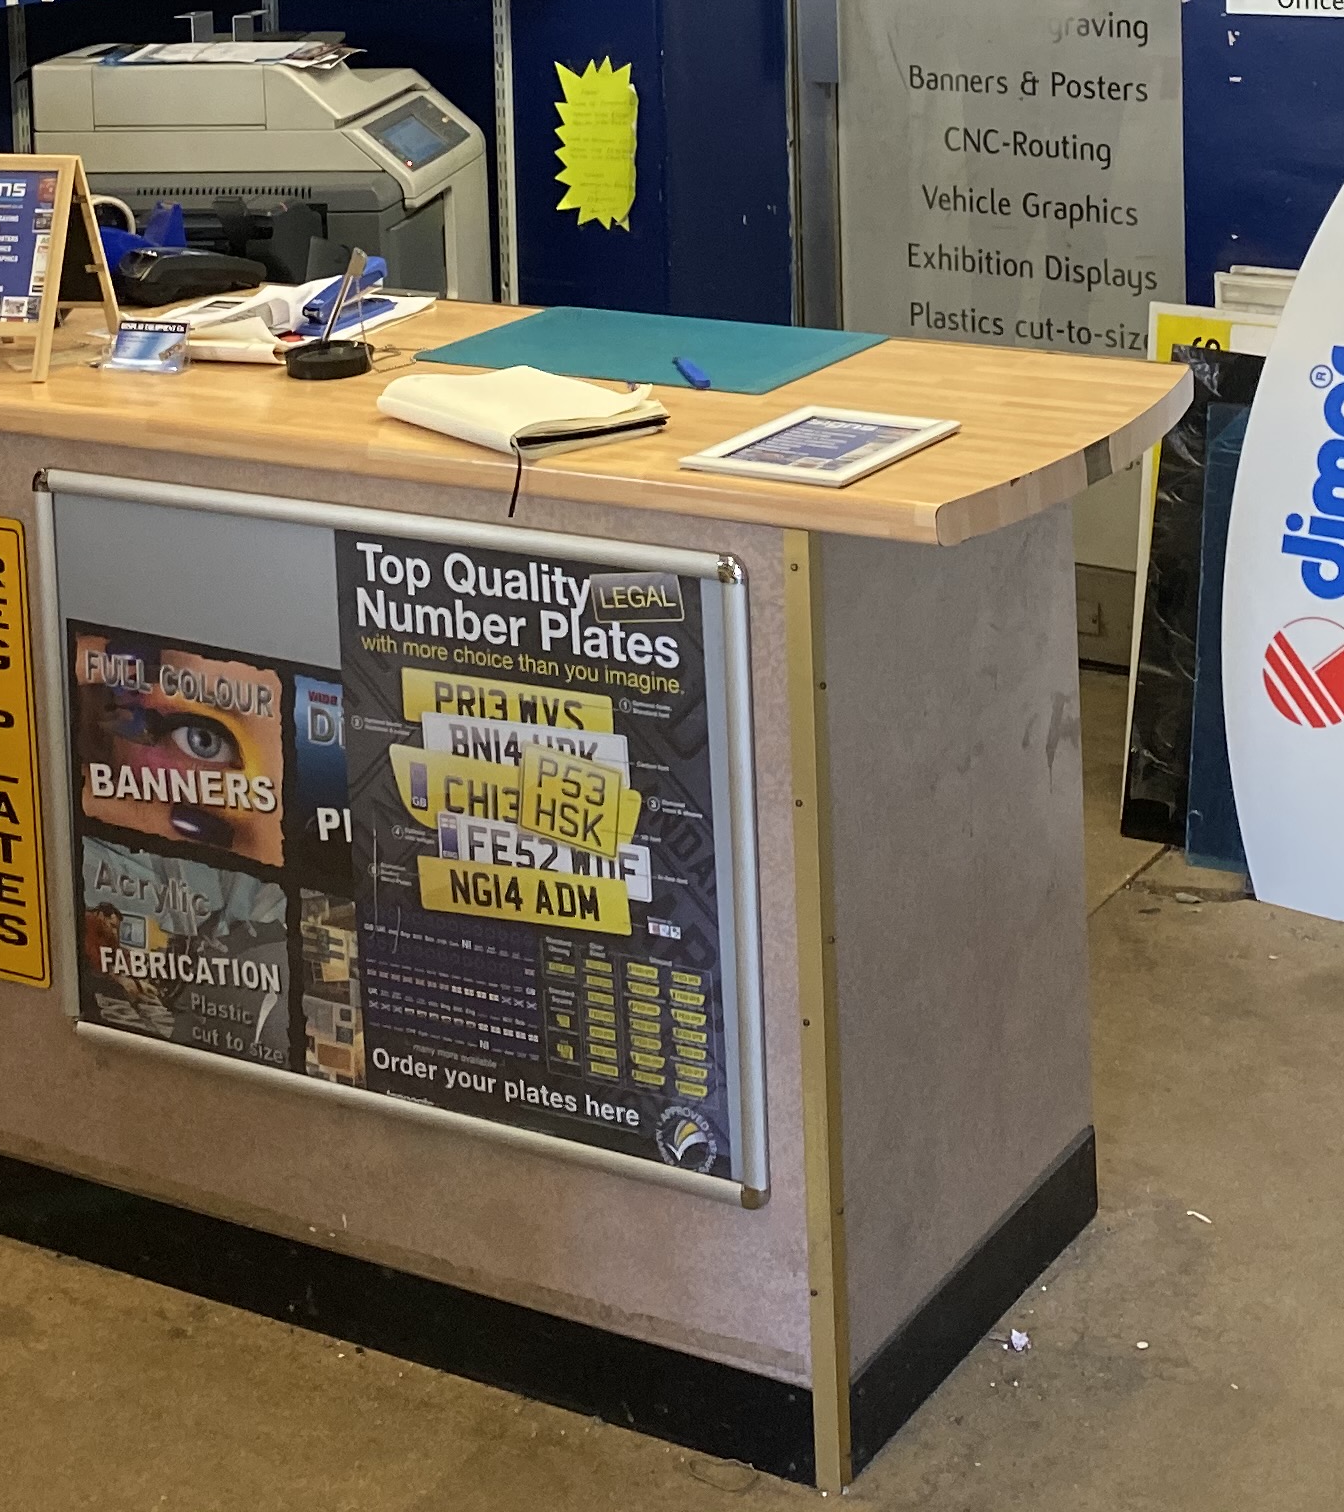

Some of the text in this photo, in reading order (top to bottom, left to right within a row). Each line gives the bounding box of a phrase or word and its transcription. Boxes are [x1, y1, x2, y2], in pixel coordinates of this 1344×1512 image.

[908, 64, 1149, 102] Banners & Posters
[944, 126, 1112, 170] CNC-Routing
[922, 184, 1139, 229] Vehicle Graphics
[907, 242, 1158, 297] Exhibition Displays
[910, 302, 1005, 337] Plastics
[356, 541, 592, 616] Top Quality
[599, 584, 678, 610] LEGAL
[356, 586, 681, 670] Number Plates
[85, 649, 275, 719] FULL COLOUR
[361, 634, 398, 656] with
[402, 643, 449, 663] more
[453, 645, 514, 672] choice
[518, 653, 560, 677] than
[564, 662, 599, 686] you
[518, 692, 586, 732] WVS
[89, 761, 278, 813] BANNERS
[411, 795, 427, 809] GB
[538, 756, 606, 807] P53
[535, 794, 604, 848] HSK
[467, 825, 559, 873] FE52
[94, 858, 211, 918] Acrylic
[535, 879, 601, 922] ADM
[99, 945, 282, 993] FABRICATION
[190, 992, 254, 1026] Plastic
[192, 1026, 285, 1065] cut to size
[372, 1046, 640, 1127] Order your plates here
